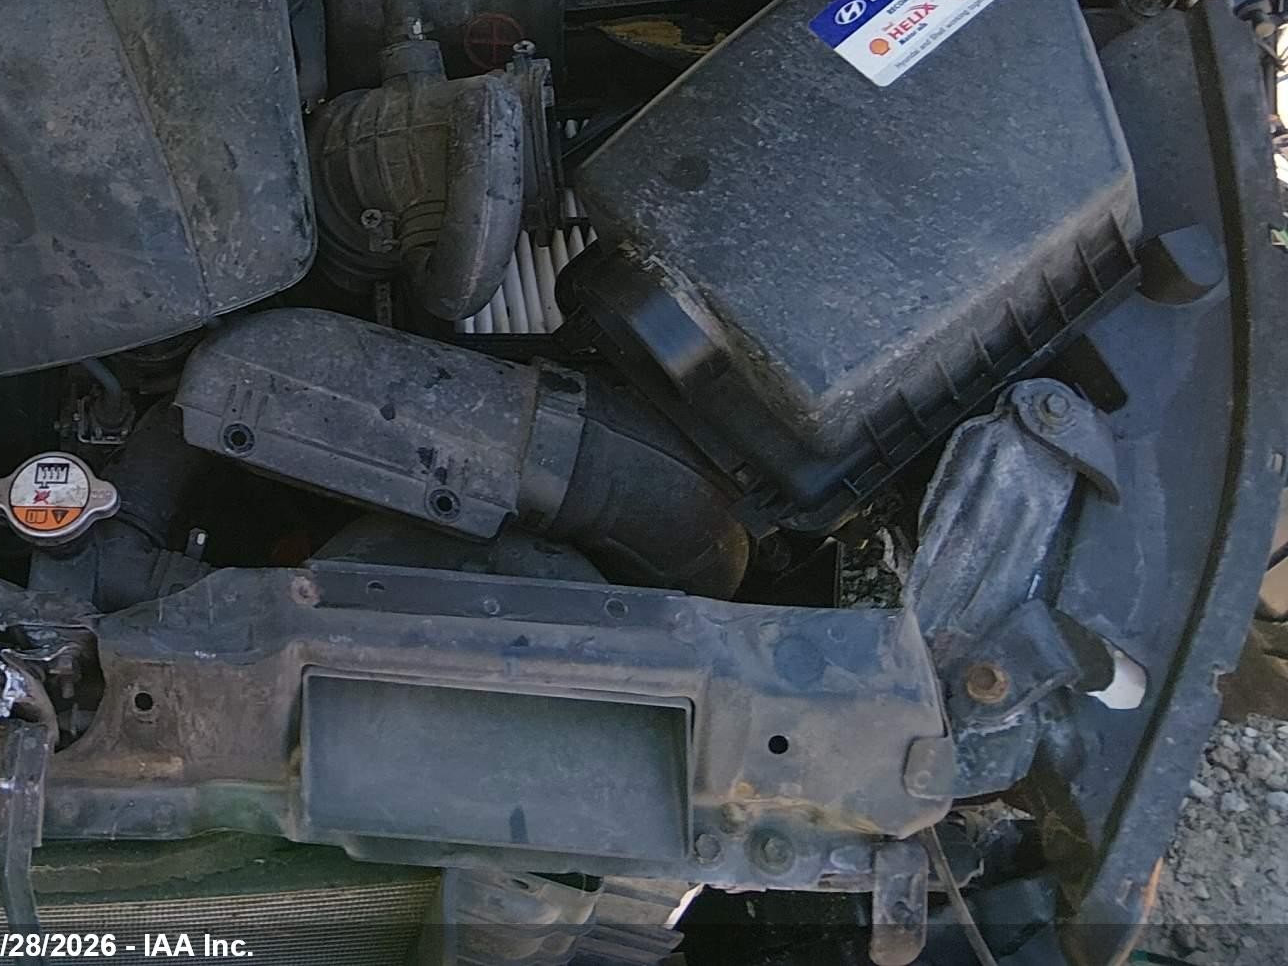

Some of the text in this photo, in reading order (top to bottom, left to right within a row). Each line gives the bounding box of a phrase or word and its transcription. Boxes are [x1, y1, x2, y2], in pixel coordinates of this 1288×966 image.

[887, 1, 939, 40] HELIX
[920, 37, 932, 50] and
[946, 9, 970, 30] working
